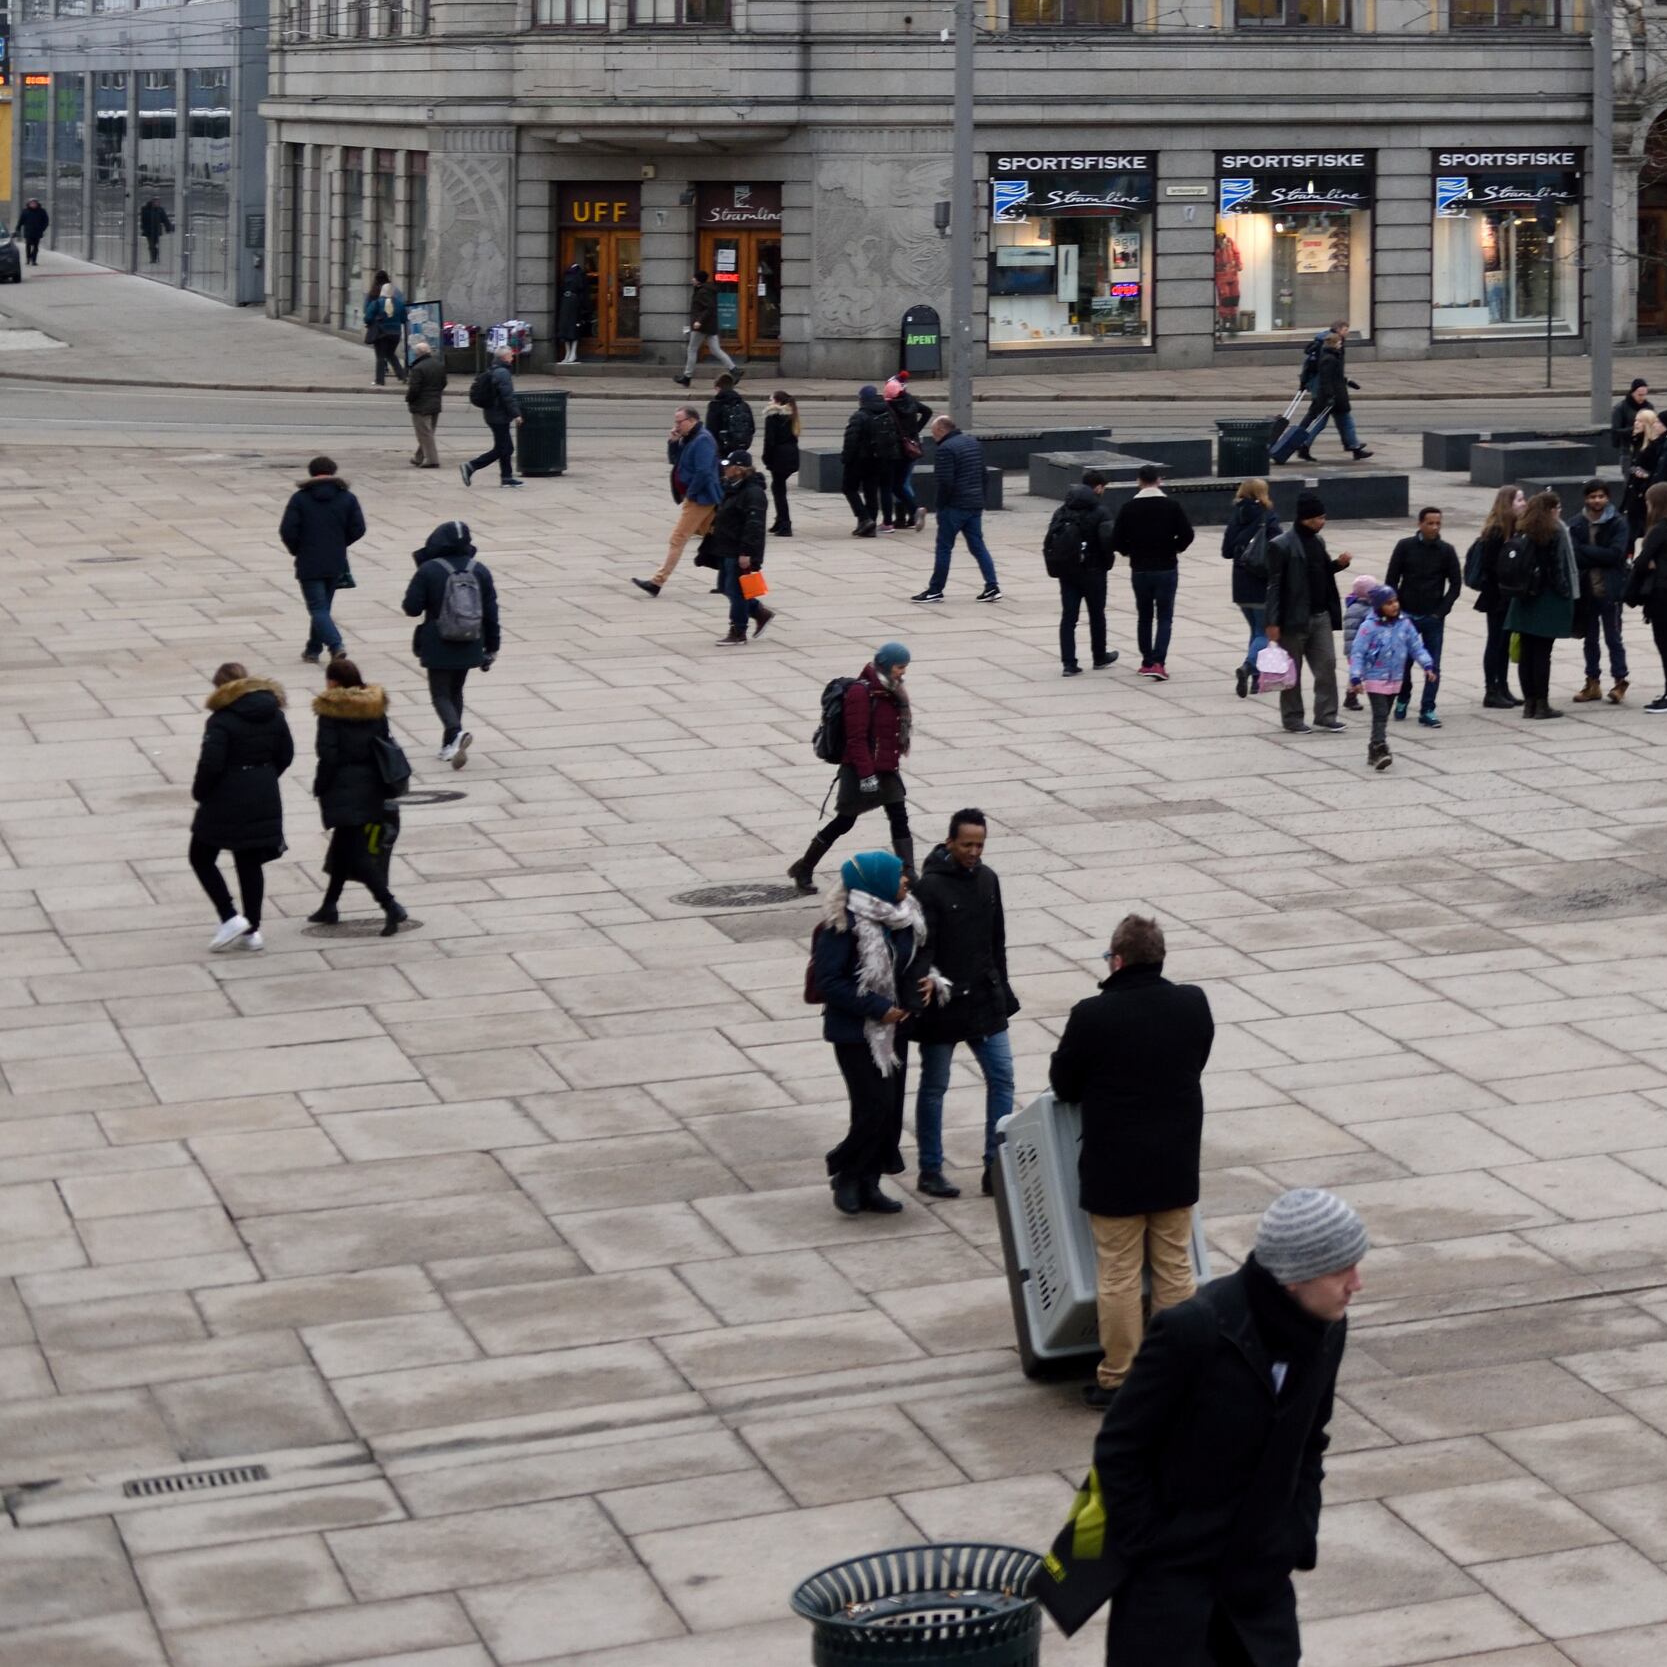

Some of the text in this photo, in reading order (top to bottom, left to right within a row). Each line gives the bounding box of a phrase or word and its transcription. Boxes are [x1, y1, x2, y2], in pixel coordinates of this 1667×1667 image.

[997, 156, 1148, 171] SPORTSFISKE
[1222, 154, 1366, 168] SPORTSFISKE
[1438, 152, 1576, 167] SPORTSFISKE
[573, 201, 628, 223] UFF
[906, 334, 938, 345] ÅPENT
